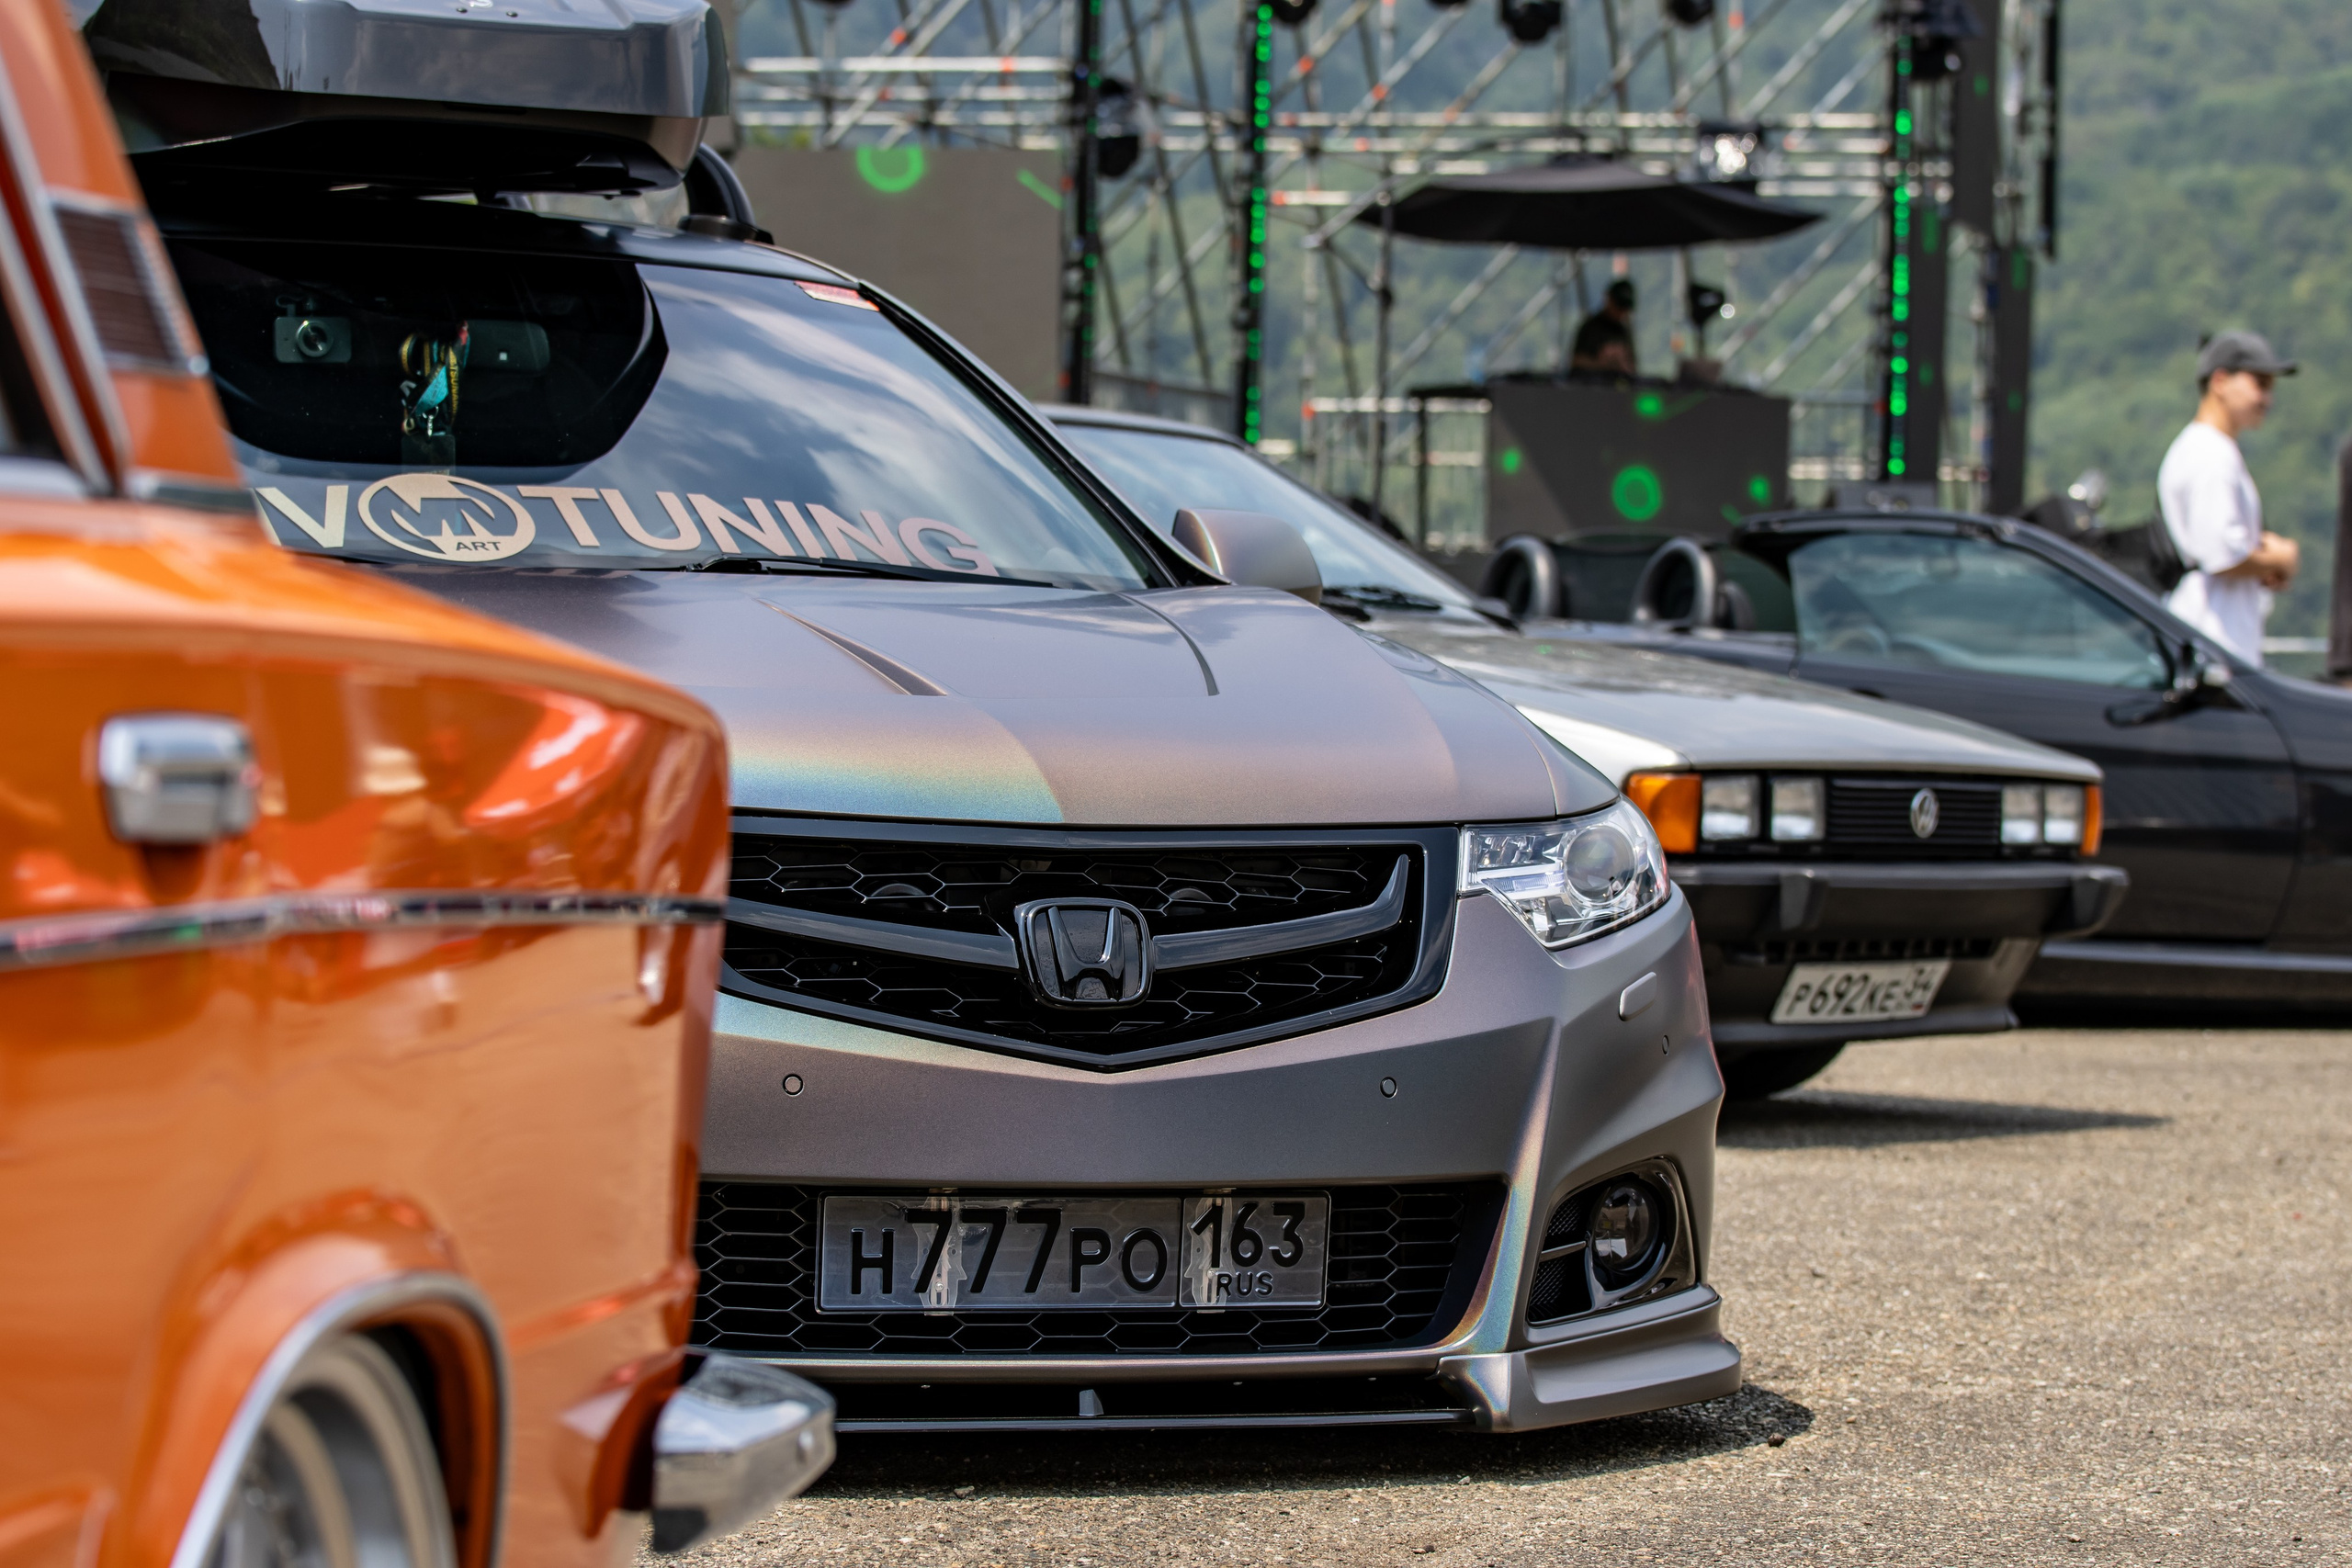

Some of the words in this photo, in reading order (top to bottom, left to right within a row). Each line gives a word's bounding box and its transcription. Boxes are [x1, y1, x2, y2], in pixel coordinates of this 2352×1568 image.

[456, 541, 502, 551] ART
[516, 485, 1000, 577] TUNING
[1190, 1197, 1306, 1269] 163
[1215, 1271, 1274, 1298] RUS
